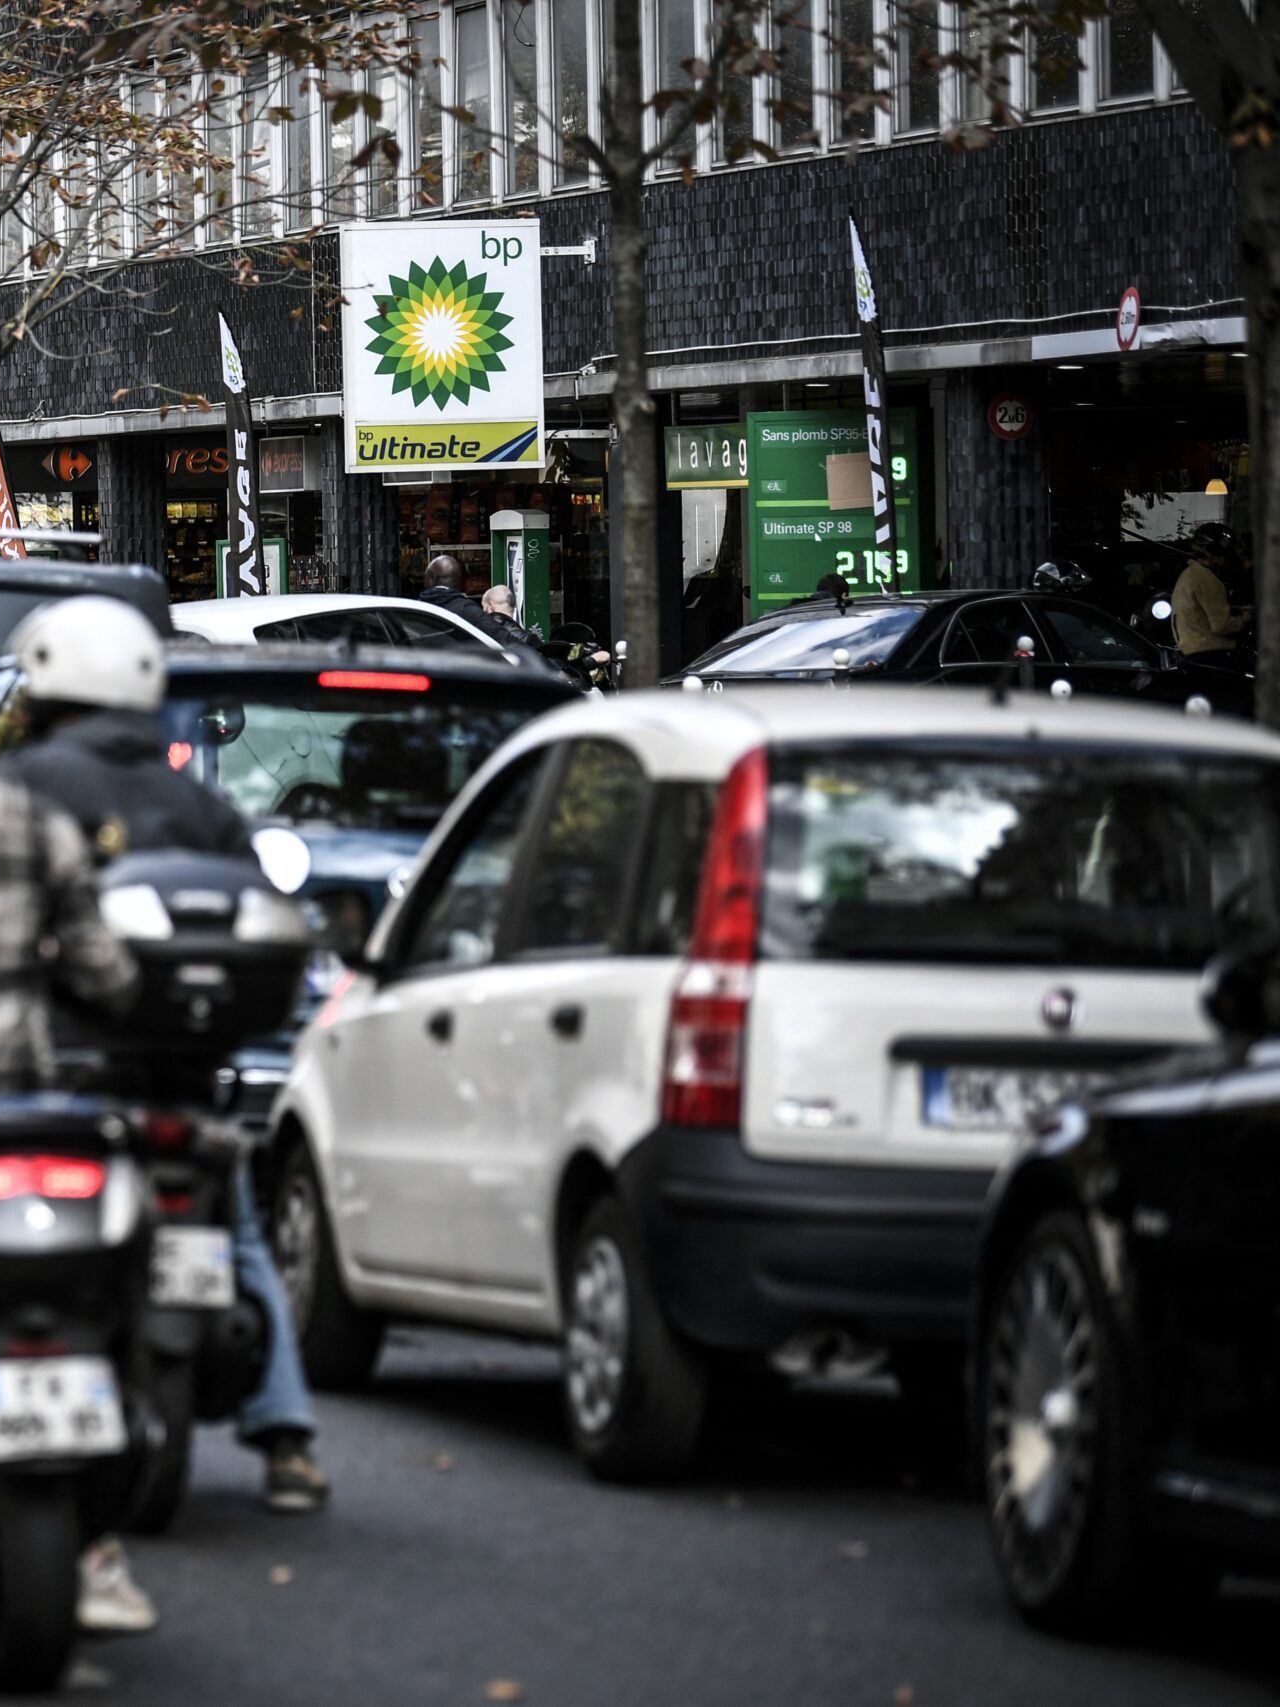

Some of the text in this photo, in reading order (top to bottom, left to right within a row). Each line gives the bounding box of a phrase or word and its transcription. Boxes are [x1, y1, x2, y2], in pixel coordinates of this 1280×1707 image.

[481, 230, 523, 267] bp
[358, 430, 374, 442] bp
[358, 435, 481, 461] ultimate
[762, 428, 790, 442] Sans
[792, 428, 828, 444] plomb
[272, 452, 302, 481] express
[677, 432, 748, 477] lavag
[763, 521, 853, 535] Ultimate SP 98
